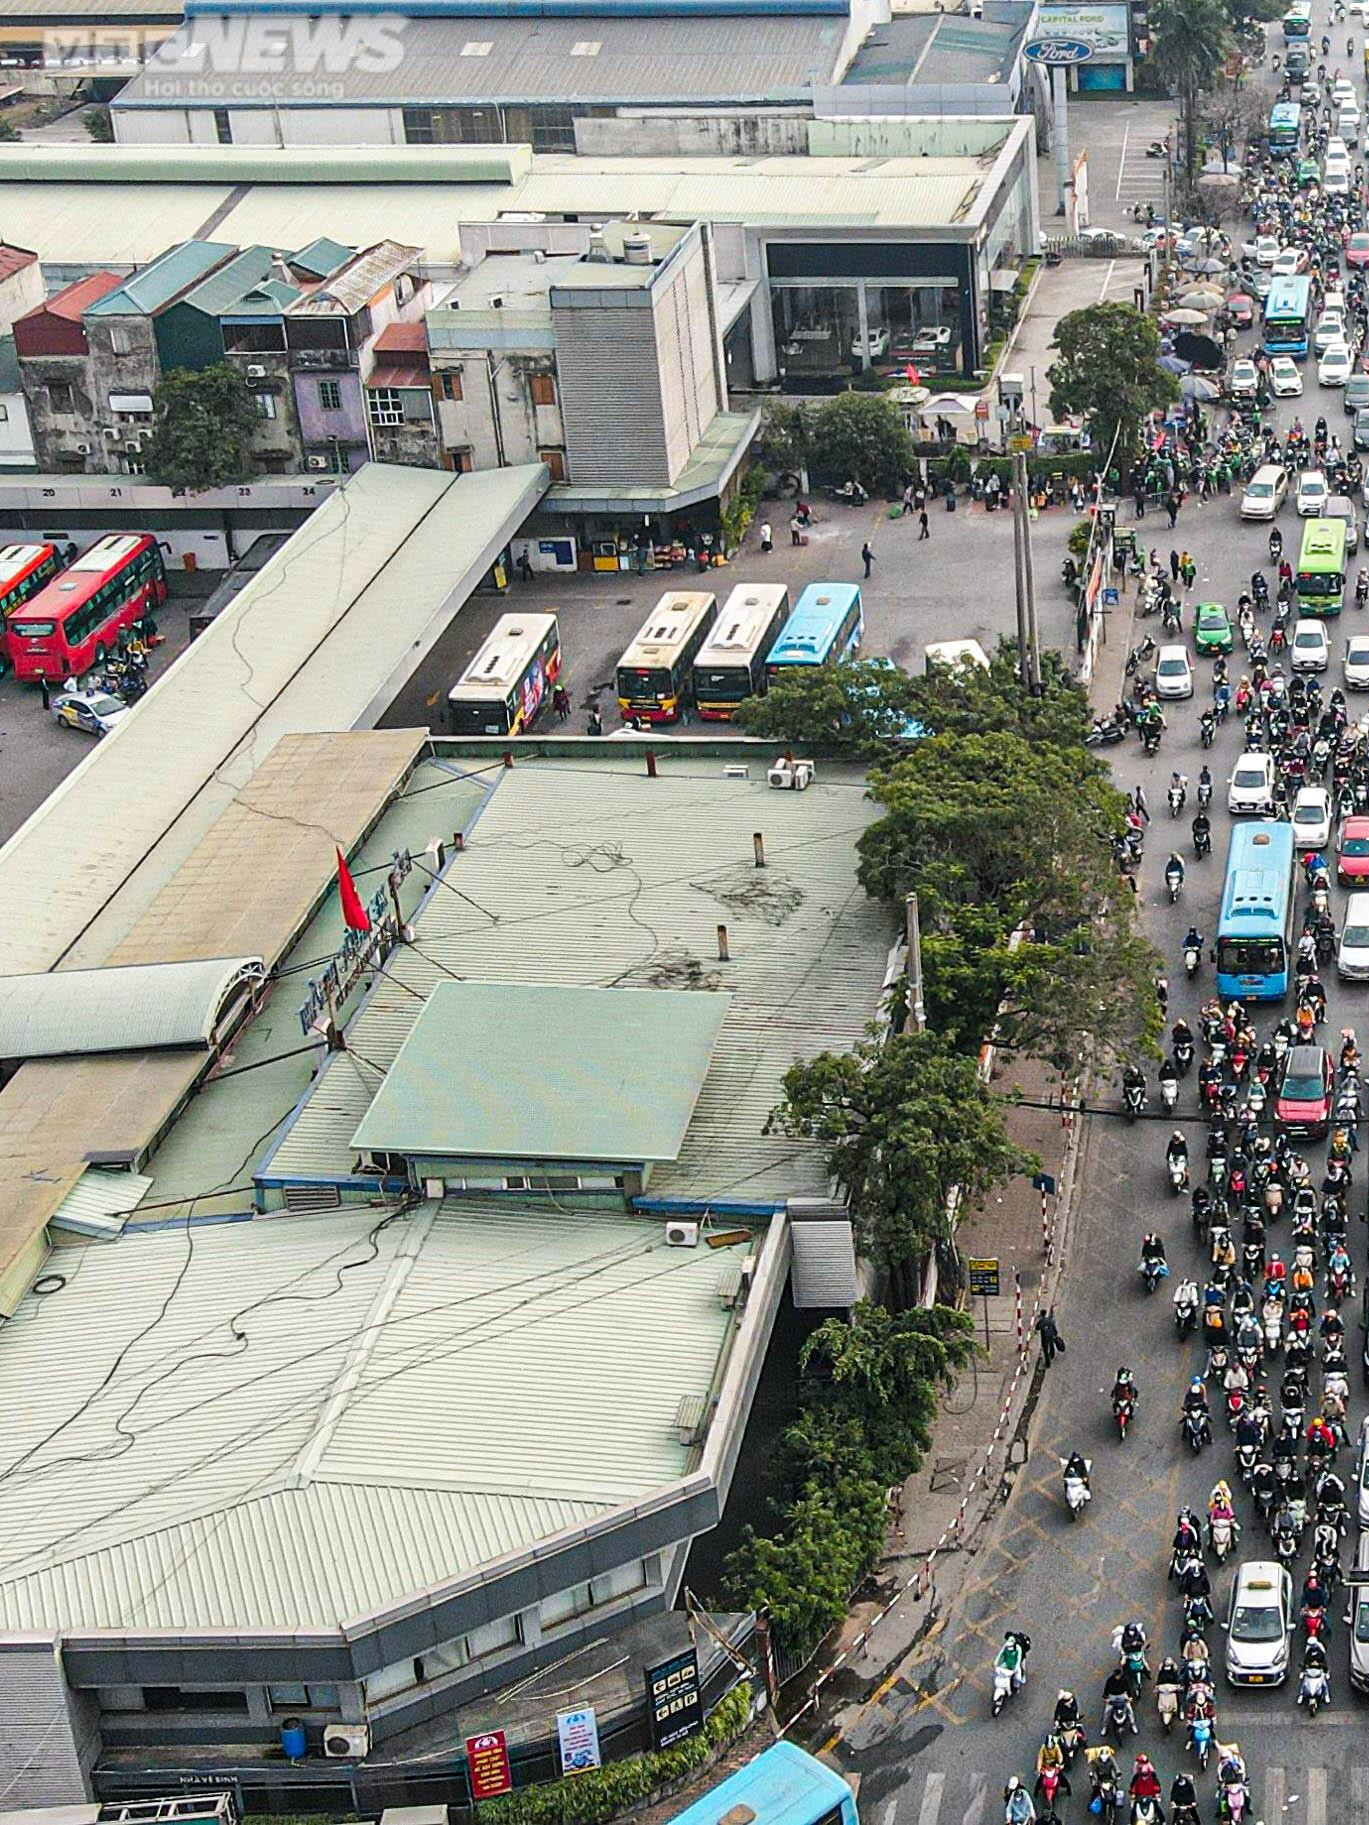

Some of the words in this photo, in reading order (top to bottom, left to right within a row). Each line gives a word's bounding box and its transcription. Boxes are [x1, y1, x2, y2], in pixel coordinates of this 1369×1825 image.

[1037, 41, 1079, 59] Ford
[42, 488, 55, 497] 20
[109, 488, 122, 497] 21
[302, 487, 315, 496] 24
